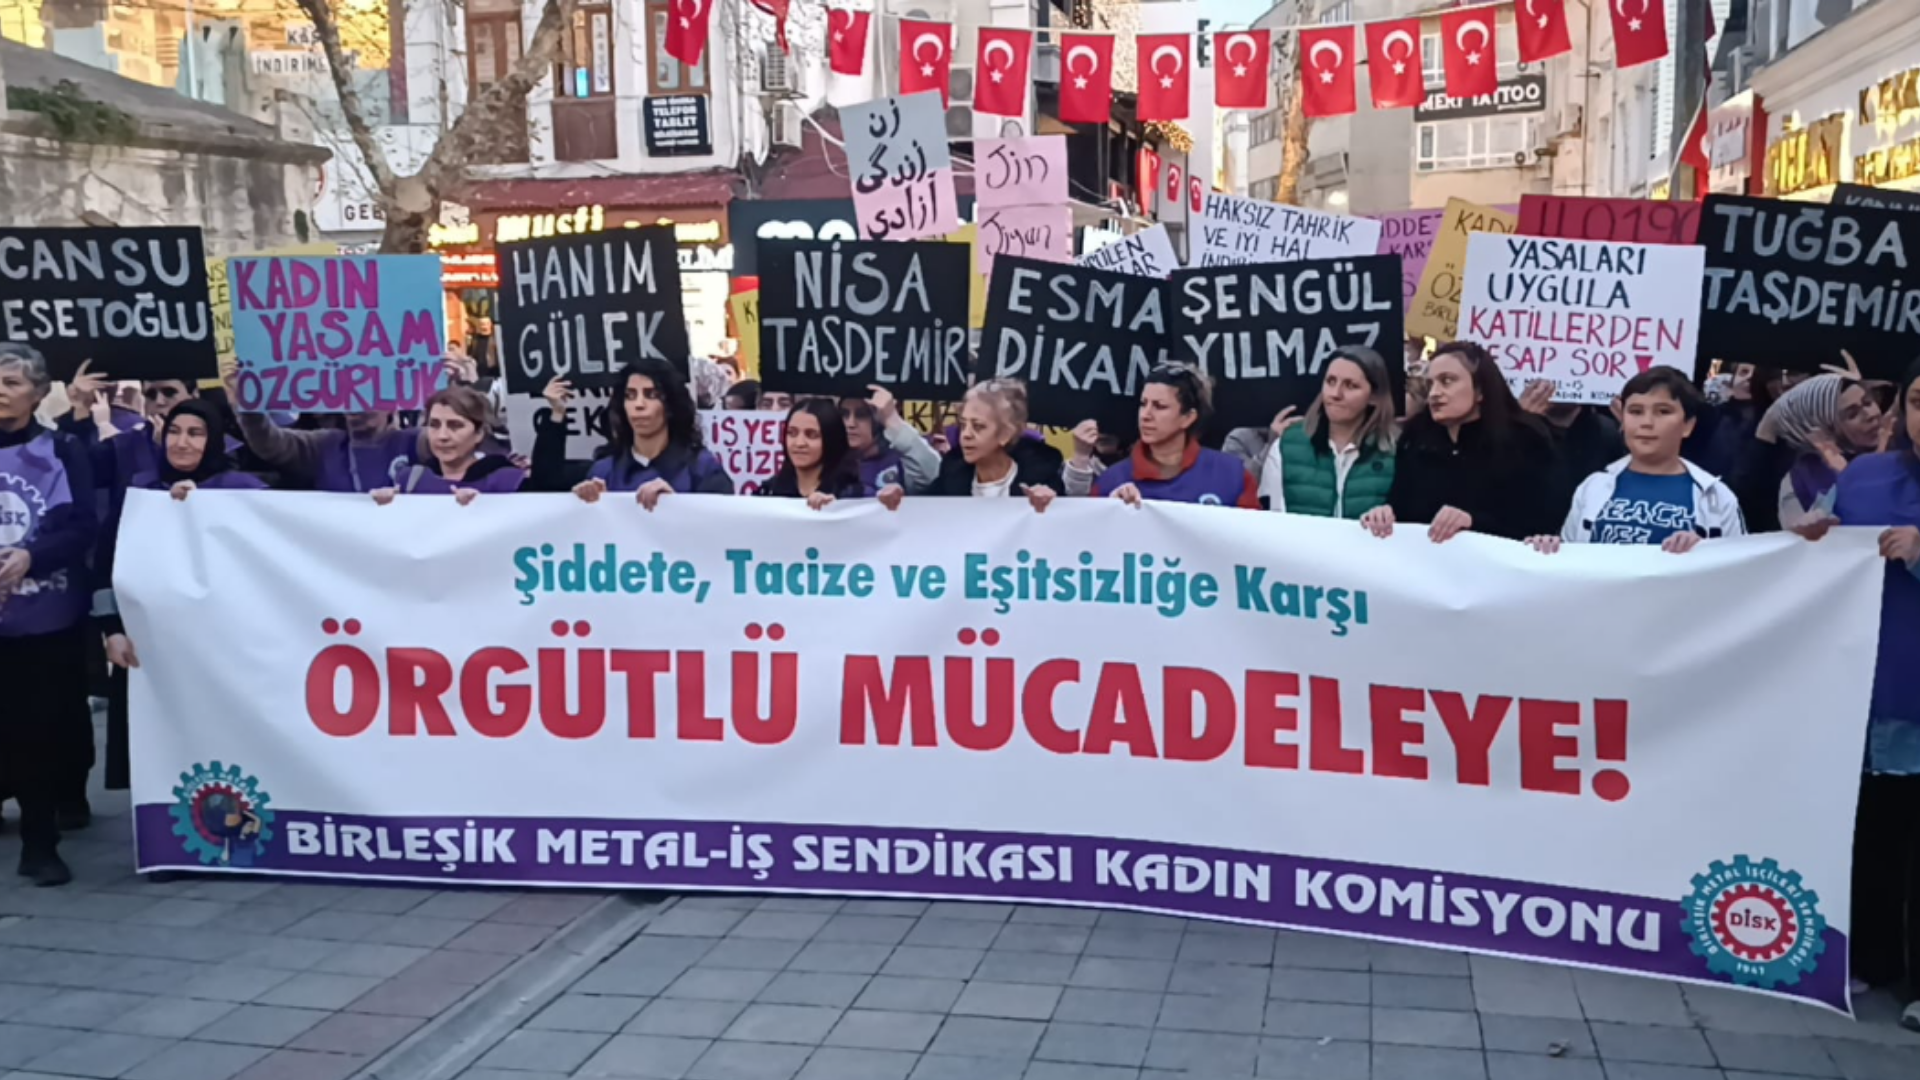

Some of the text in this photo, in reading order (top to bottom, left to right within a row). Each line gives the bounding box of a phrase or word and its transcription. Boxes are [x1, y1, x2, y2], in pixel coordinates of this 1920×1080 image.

[654, 116, 698, 129] TABLET
[869, 98, 900, 138] زن
[856, 139, 927, 194] زندگی
[985, 144, 1049, 189] Jin
[866, 171, 938, 240] آزادی
[1205, 194, 1355, 245] HAKSIZ TAHRİK
[0, 238, 190, 285] CANSU
[1203, 225, 1228, 248] VE
[1507, 239, 1647, 276] YASALARI
[1715, 205, 1906, 267] TUĞBA
[234, 258, 379, 312] KADIN
[513, 239, 657, 307] HANIM
[794, 241, 929, 316] NİSA
[1182, 263, 1392, 324] ŞENGÜL
[1488, 272, 1631, 309] UYGULA
[3, 292, 206, 341] ESETOĞLU
[1008, 269, 1166, 334] ESMA
[1469, 304, 1685, 351] KATİLLERDEN
[259, 308, 441, 362] YAŞAM
[519, 309, 666, 378] GÜLEK
[762, 315, 966, 386] TAŞDEMİR
[995, 325, 1168, 397] DİKAN
[1183, 322, 1381, 380] YILMAZ
[1484, 345, 1557, 374] ESAP
[513, 543, 1368, 637] Şiddete, Tacize ve Eşitsizliğe Karşı
[305, 617, 1630, 802] ÖRGÜTLÜ MÜCADELEYE!
[286, 816, 1661, 953] BİRLEŞİK METAL-İŞ SENDİKASI KADIN KOMİSYONU
